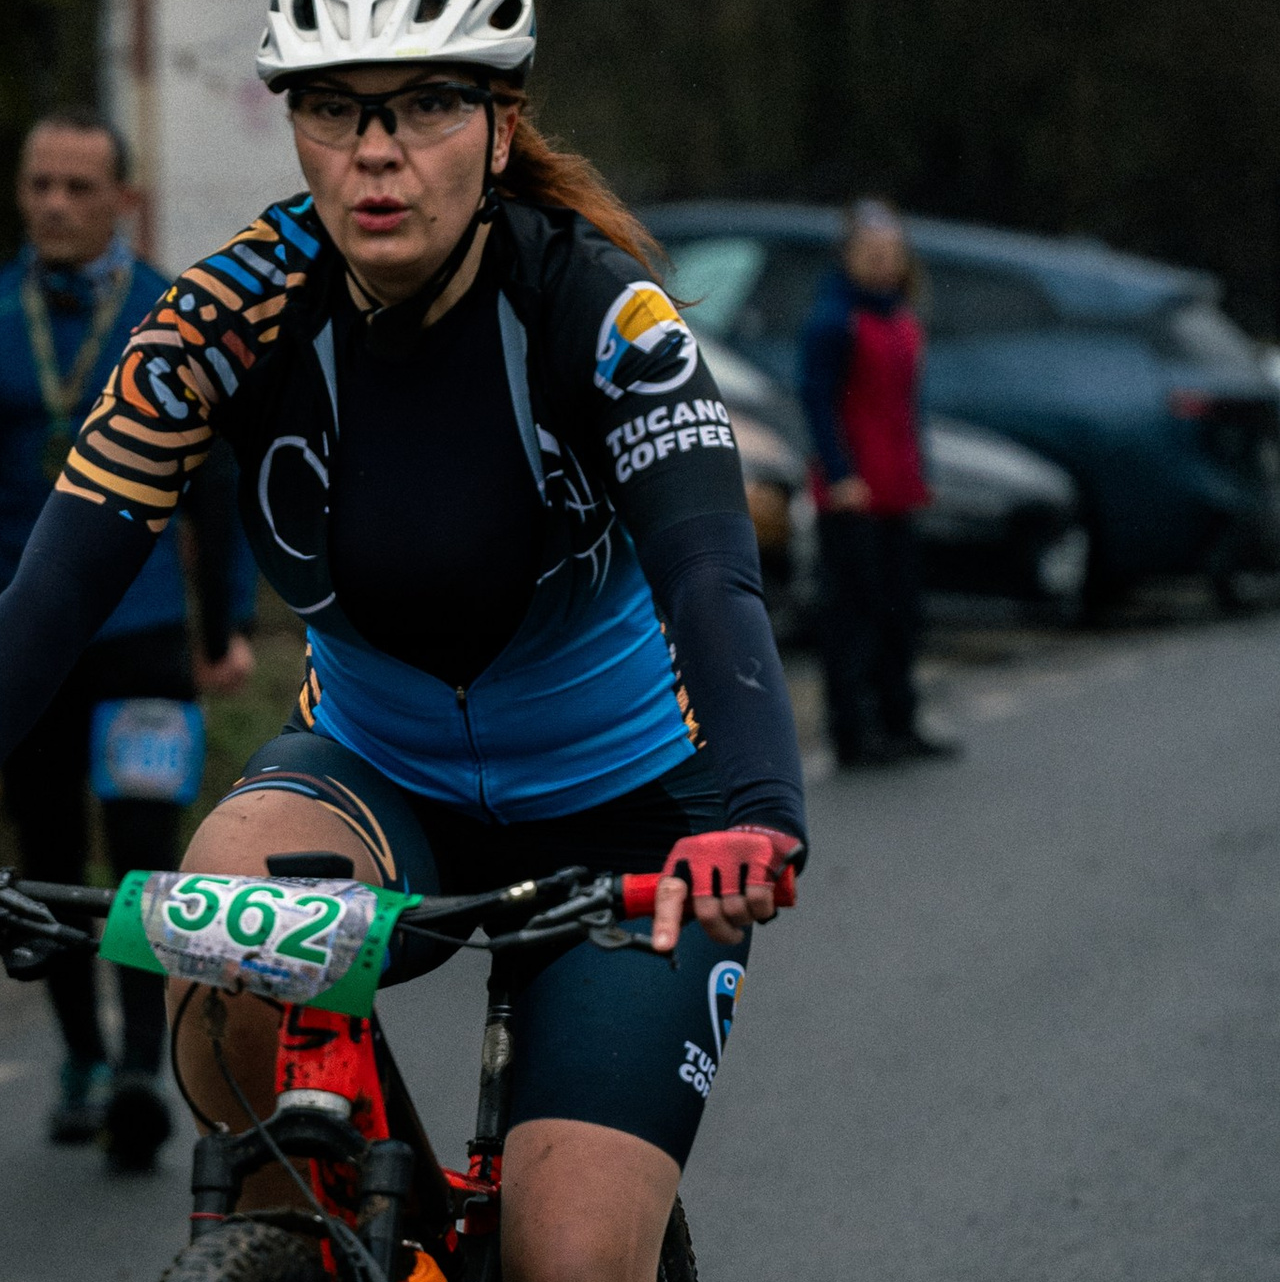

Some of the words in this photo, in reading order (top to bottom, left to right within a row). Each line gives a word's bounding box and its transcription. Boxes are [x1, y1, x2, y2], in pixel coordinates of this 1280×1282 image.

[605, 398, 731, 457] TUCANO
[615, 425, 735, 484] COFFEE
[164, 874, 344, 966] 562
